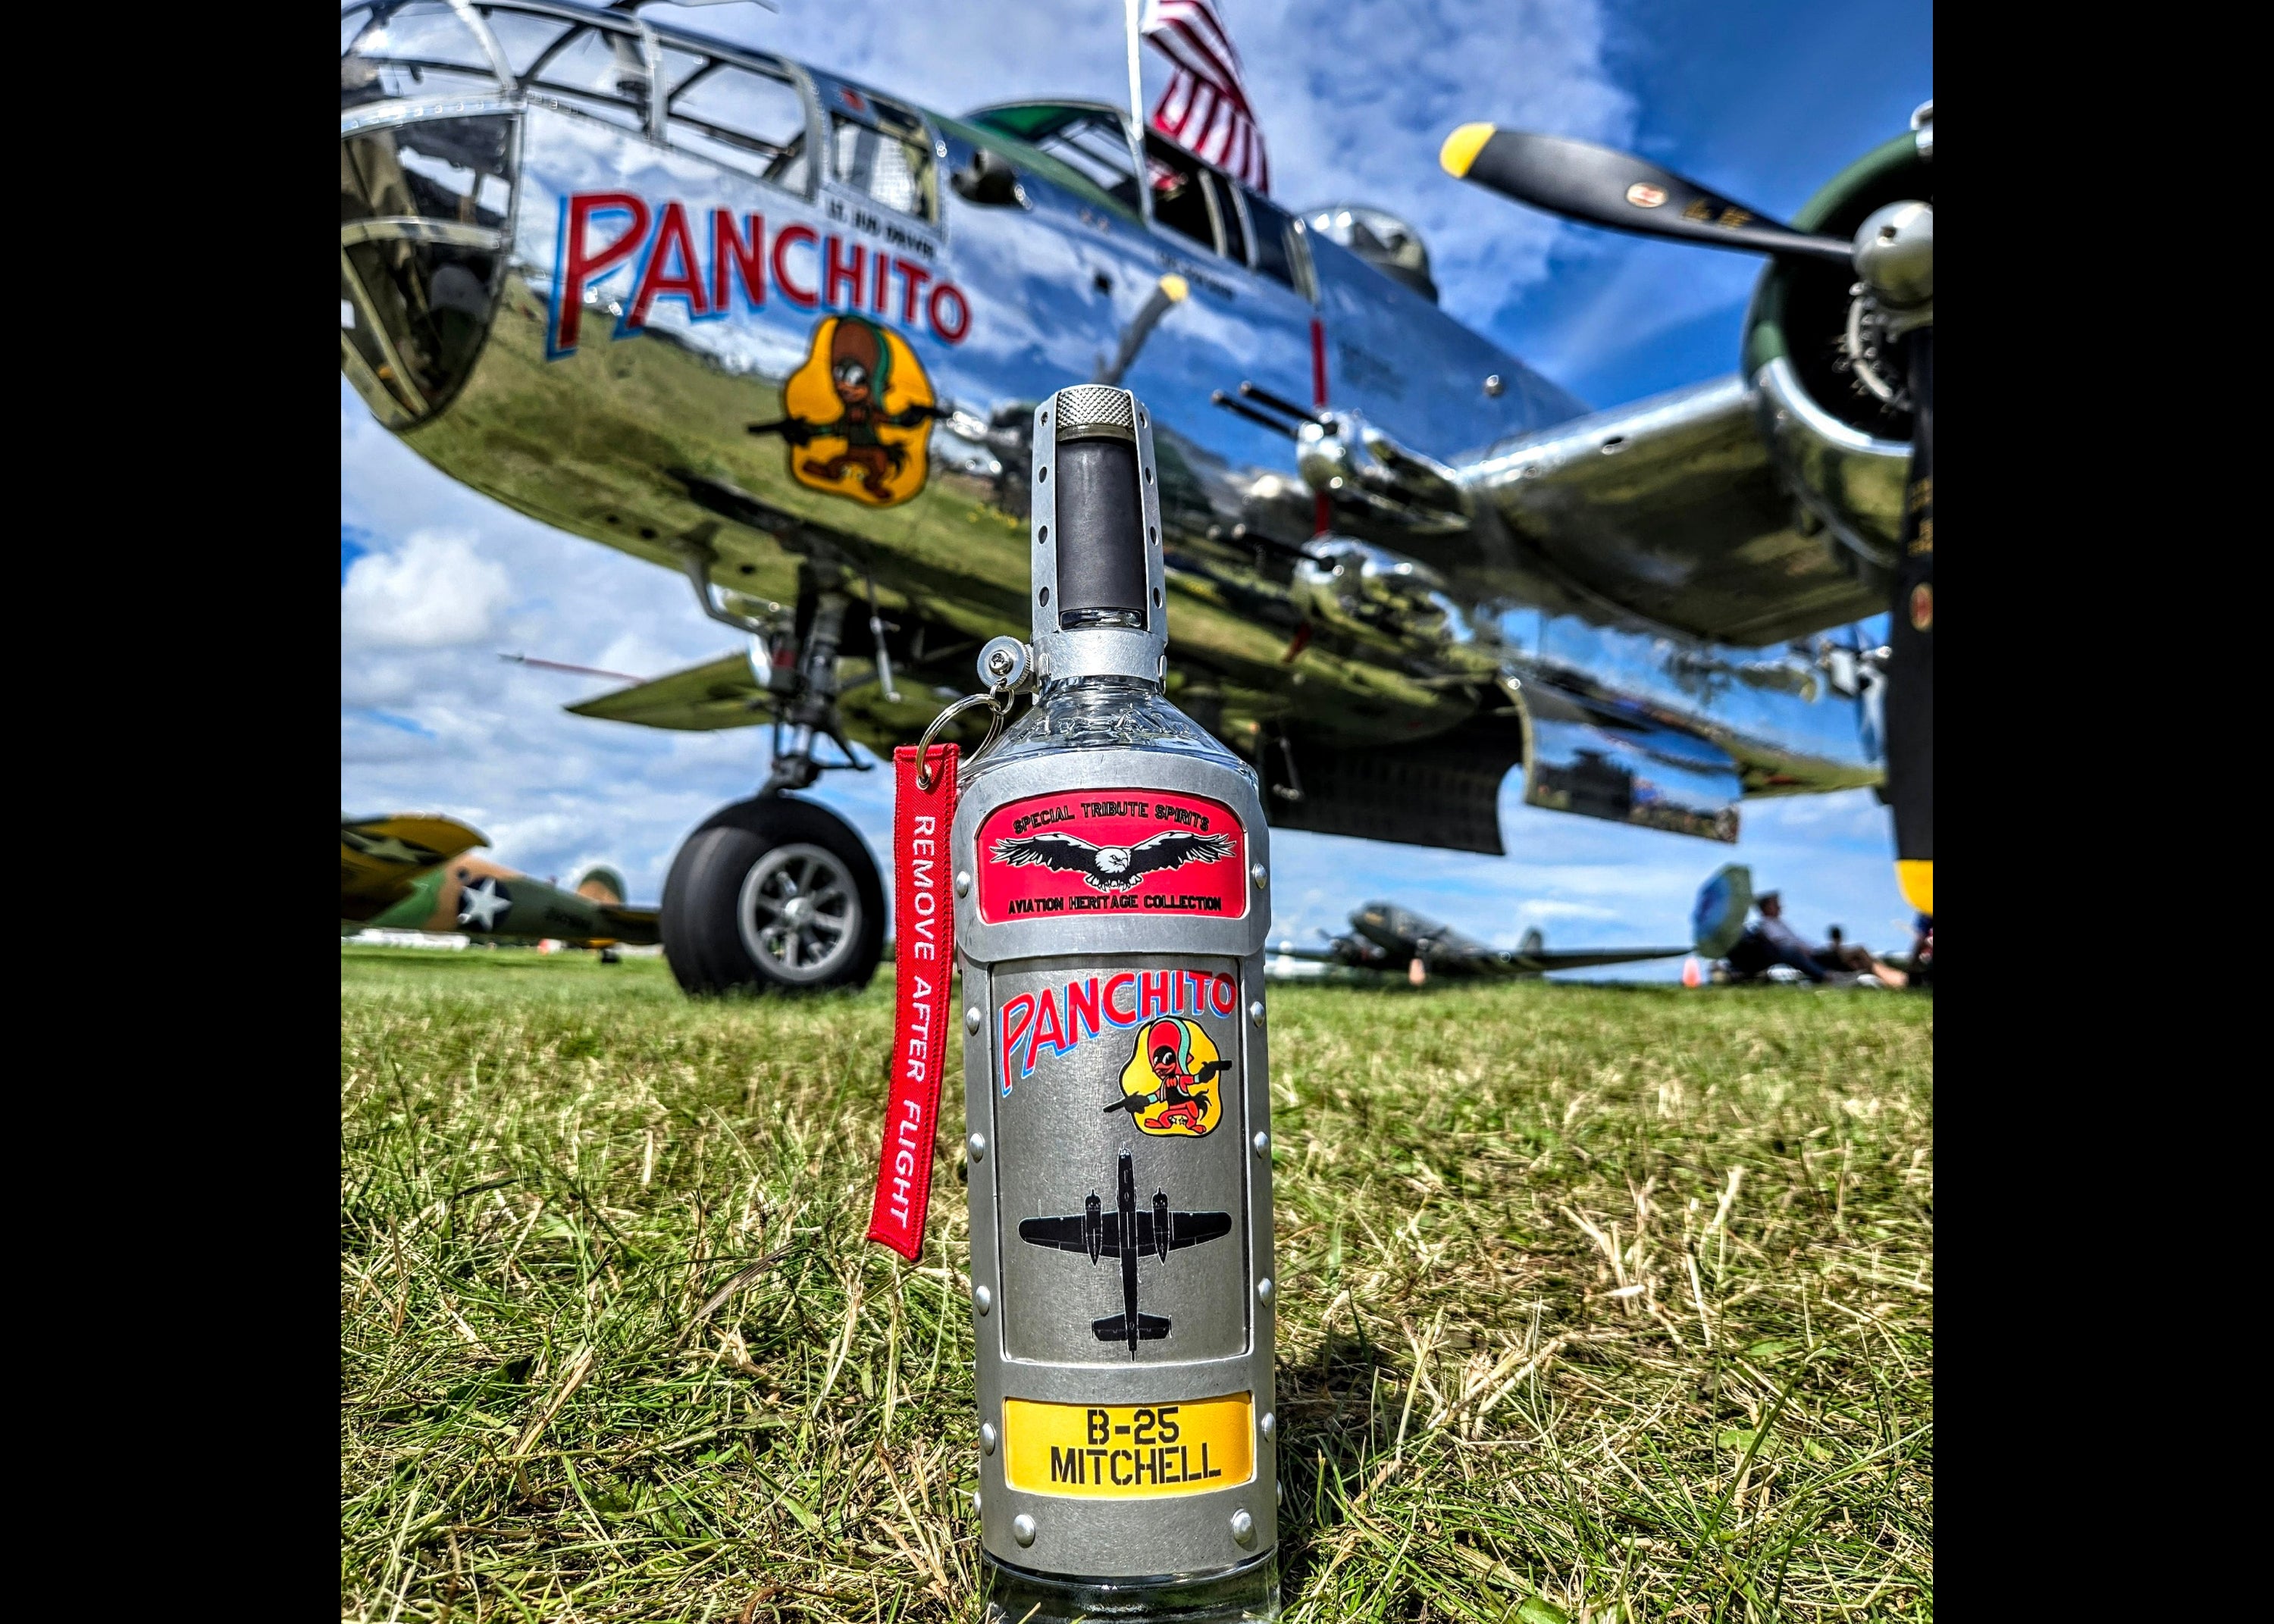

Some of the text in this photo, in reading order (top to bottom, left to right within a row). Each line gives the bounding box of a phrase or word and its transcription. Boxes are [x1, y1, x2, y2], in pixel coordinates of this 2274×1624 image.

[547, 190, 973, 359] PANCHITO
[1013, 801, 1210, 834] SPECIAL TRIBUTE SPIRITS
[1008, 894, 1222, 914] AVIATION HERITAGE COLLECTION
[890, 815, 935, 1228] REMOVE AFTER FLIGHT
[999, 969, 1238, 1098] PANCHITO
[1087, 1406, 1179, 1445] B-25
[1051, 1442, 1221, 1485] MITCHELL
